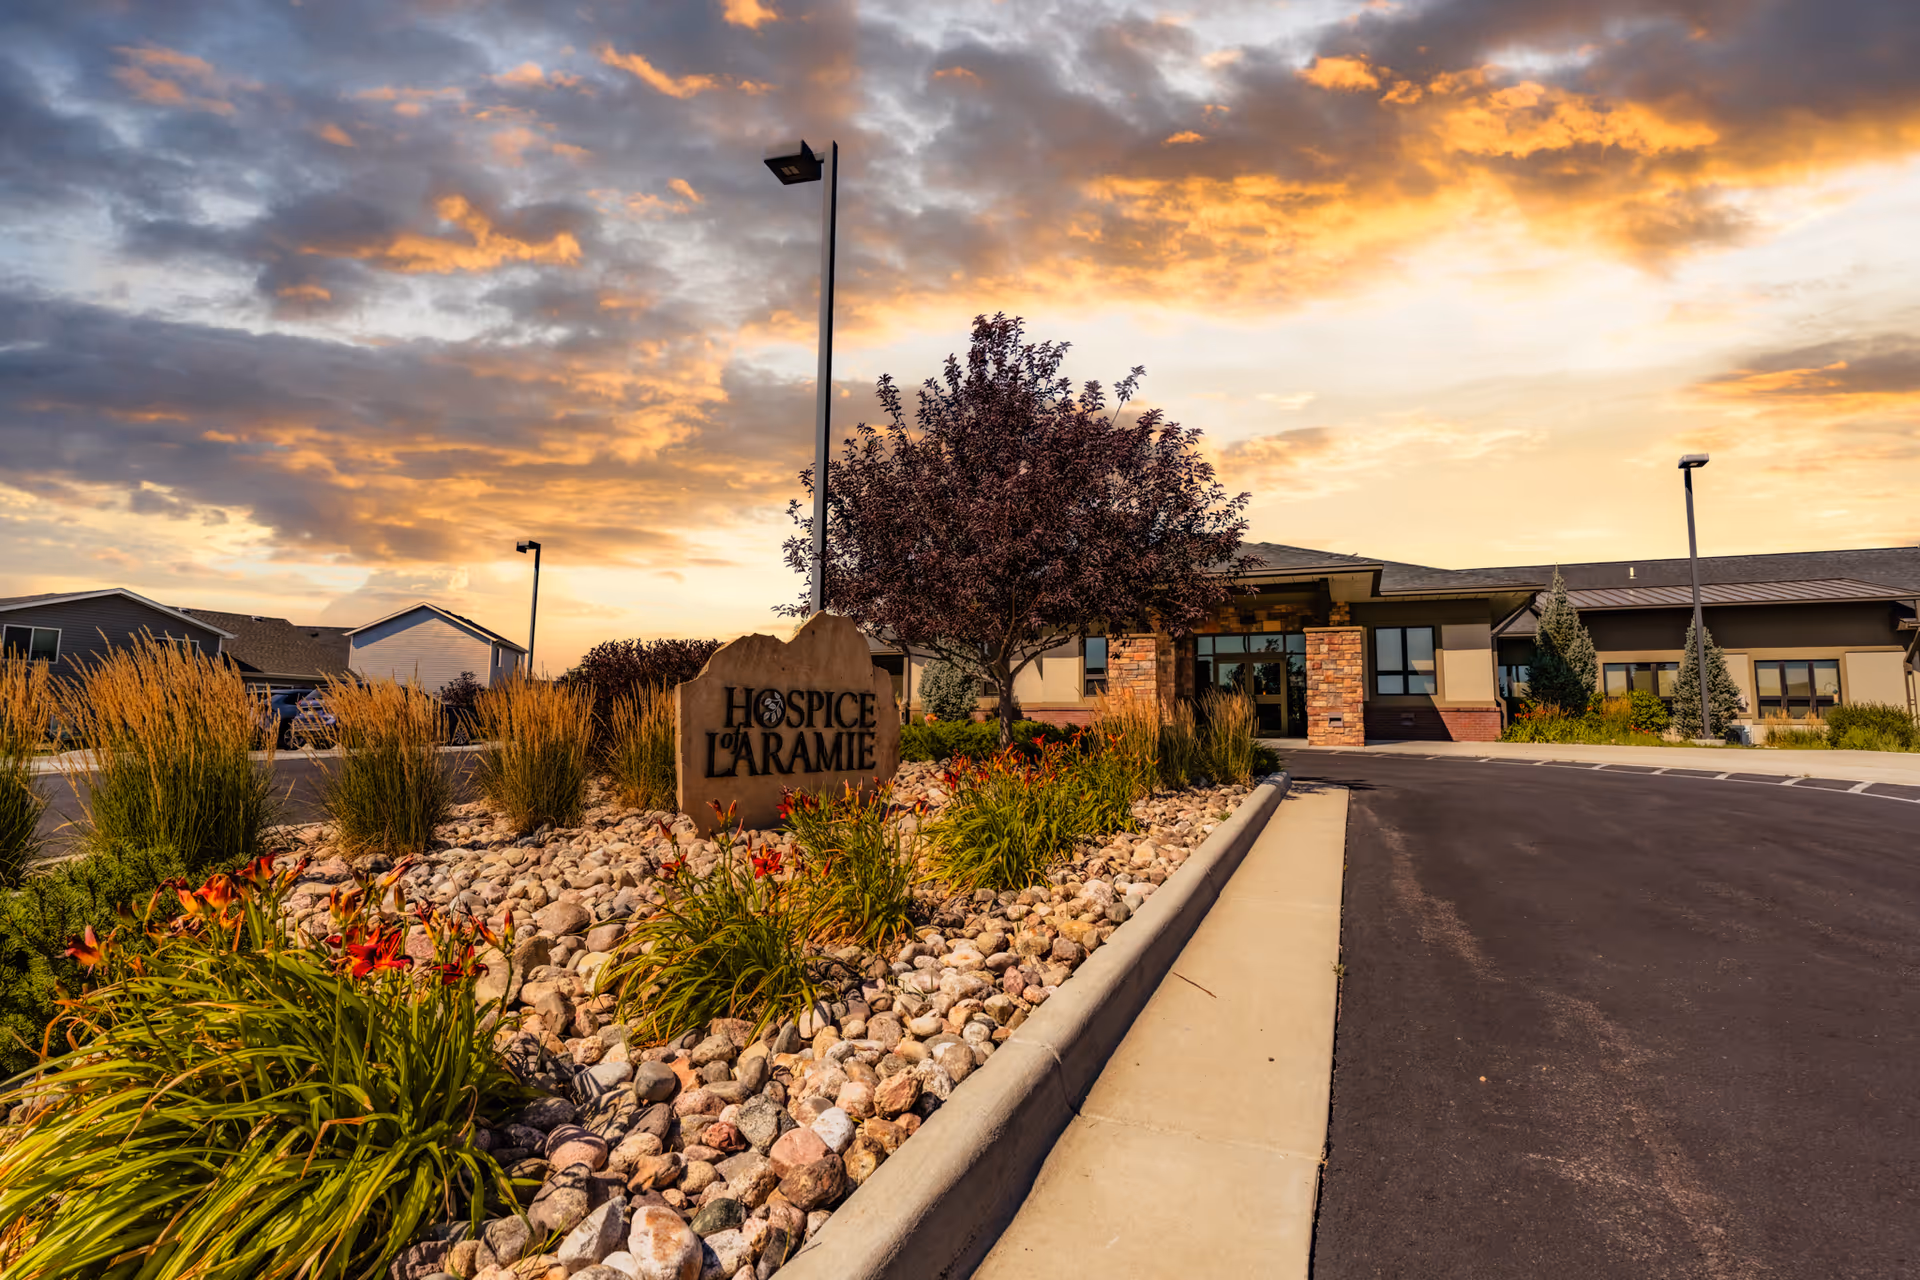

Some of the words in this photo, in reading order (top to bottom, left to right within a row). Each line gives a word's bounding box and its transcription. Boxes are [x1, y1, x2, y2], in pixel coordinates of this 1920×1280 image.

[724, 686, 877, 728] HOSPICE
[705, 731, 877, 778] LARAMIE
[720, 722, 744, 755] of
